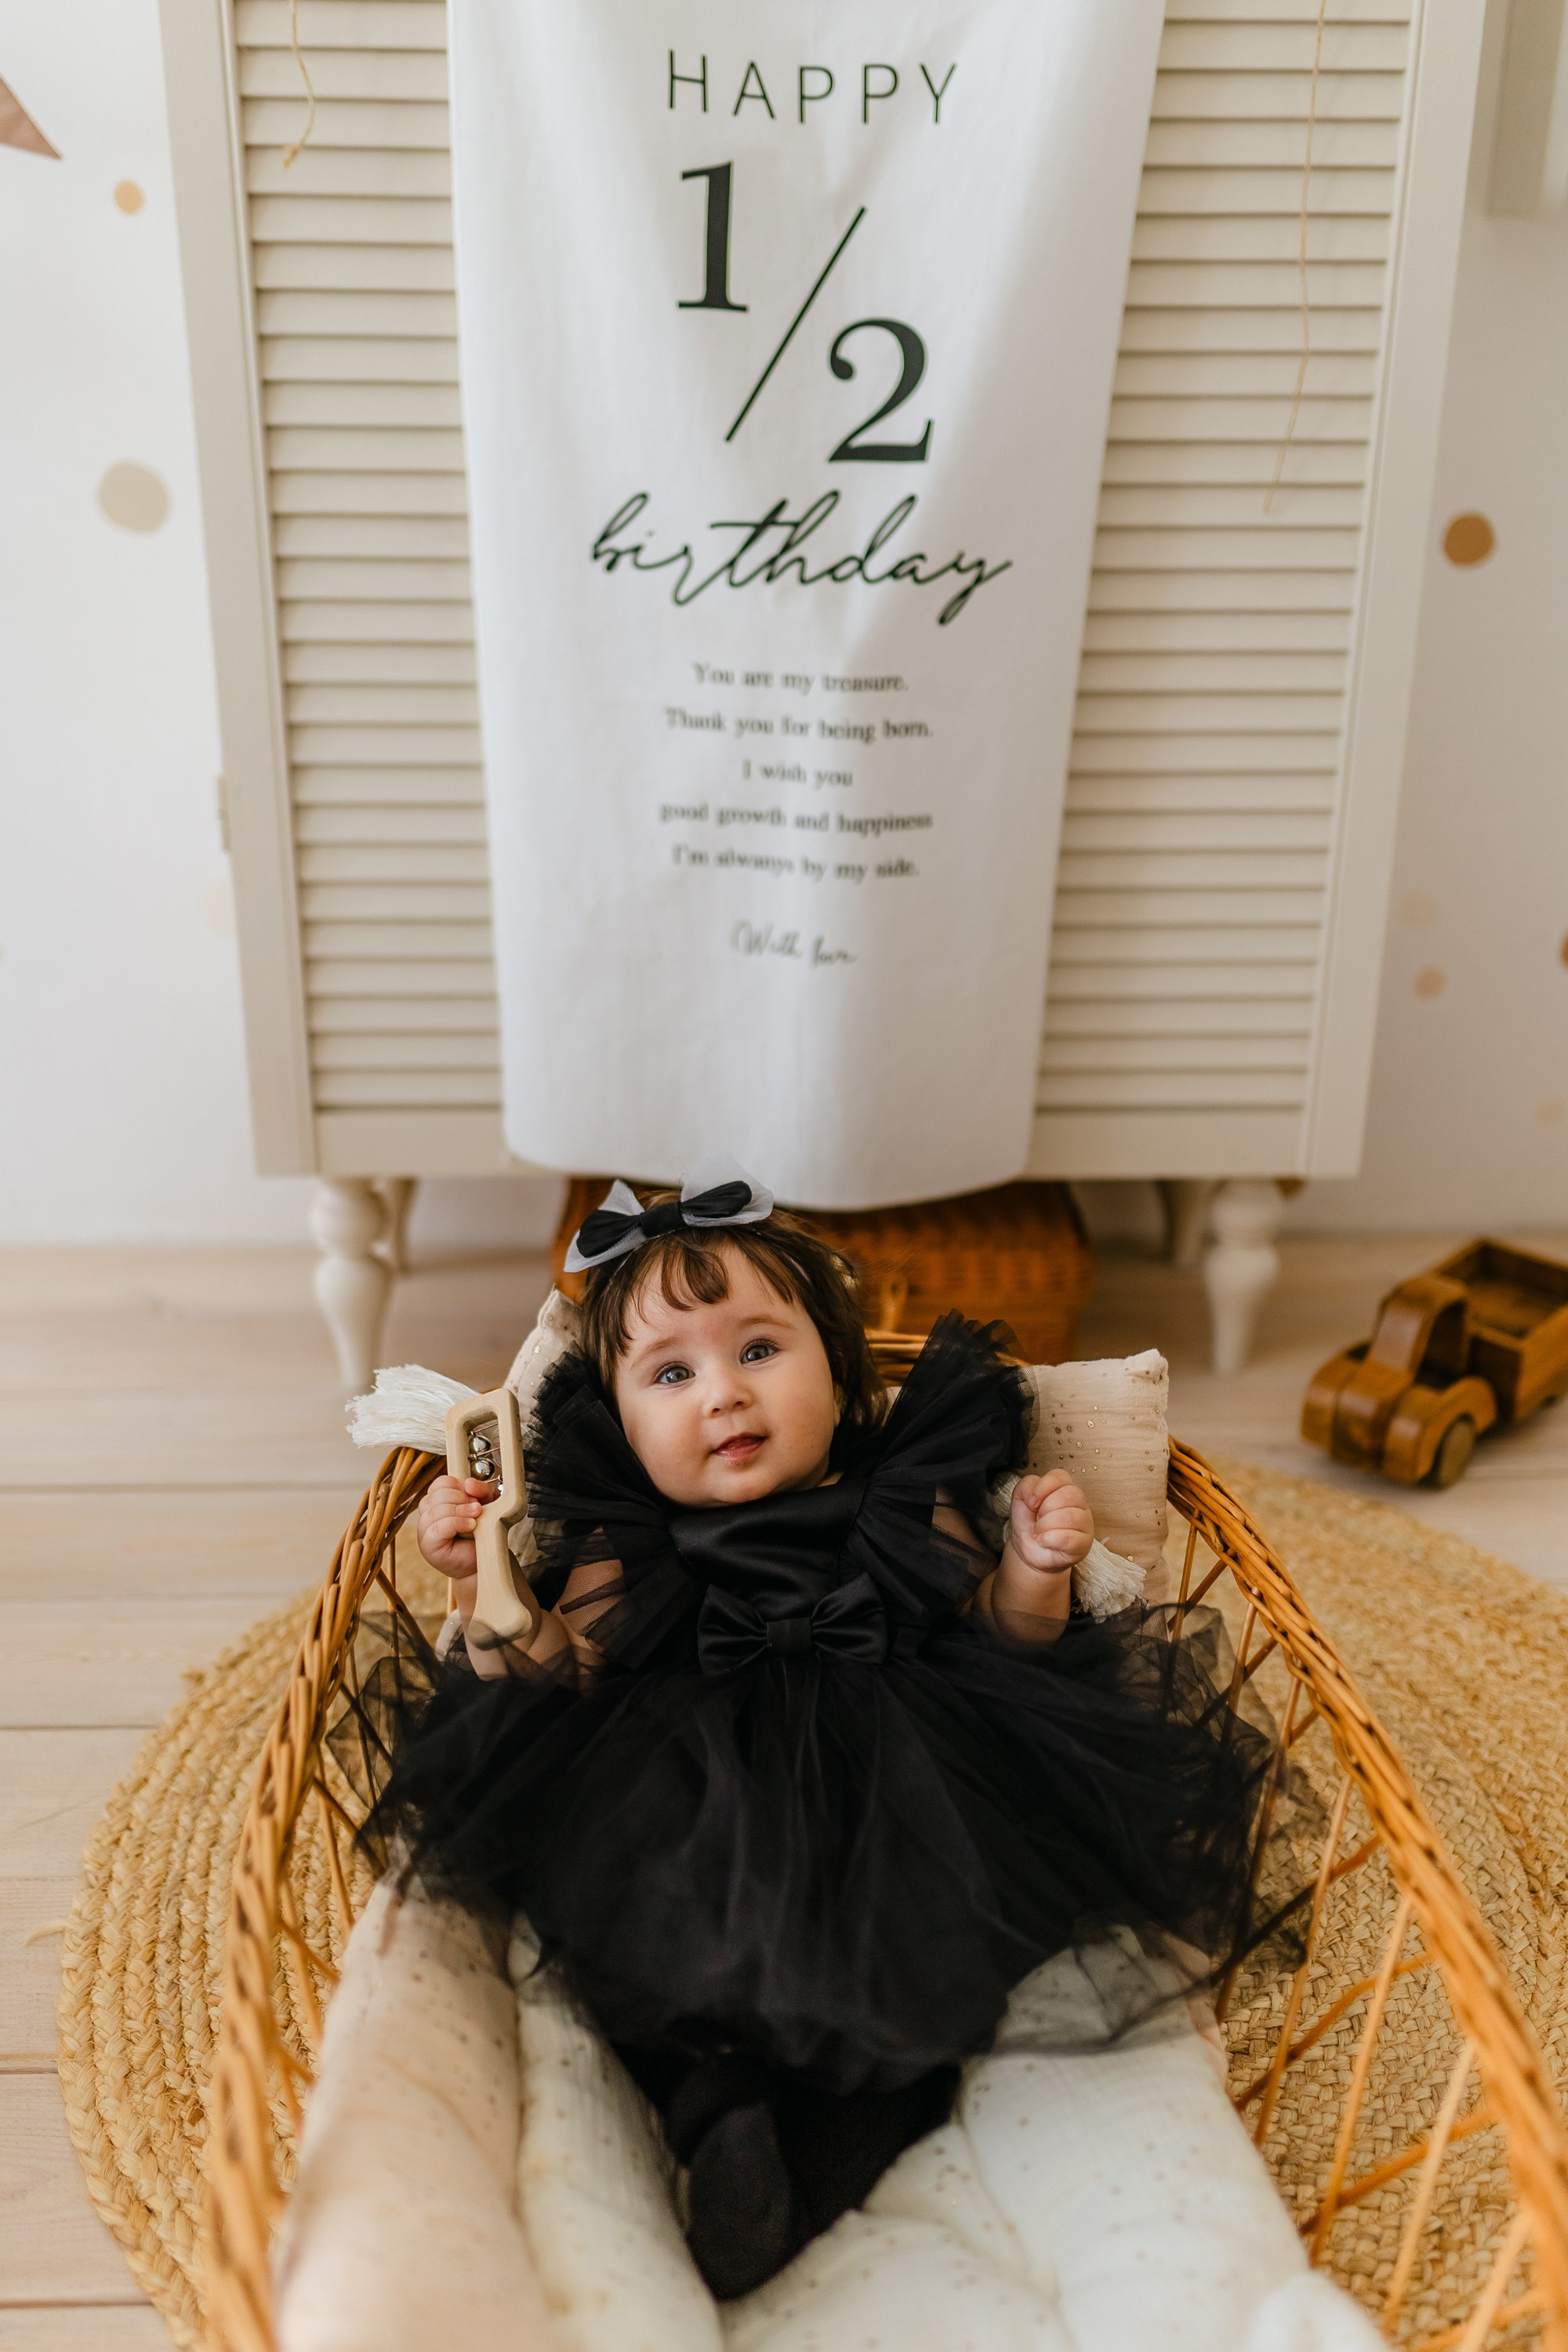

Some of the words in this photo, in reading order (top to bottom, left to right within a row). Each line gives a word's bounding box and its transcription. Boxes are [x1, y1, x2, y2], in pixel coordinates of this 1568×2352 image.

[668, 48, 958, 124] HAPPY
[591, 489, 1013, 626] birthday
[693, 662, 734, 685] You
[741, 668, 775, 687] are
[782, 673, 815, 694] my
[822, 675, 909, 692] treasure.
[666, 708, 725, 731] Thank
[734, 717, 774, 739] you
[782, 715, 810, 736] for
[818, 719, 876, 744] being
[883, 719, 935, 738] born.
[742, 760, 751, 780] I
[759, 762, 806, 783] wish
[815, 768, 854, 789] you
[659, 802, 709, 822] good
[716, 805, 785, 826] growth
[794, 812, 829, 832] and
[836, 812, 933, 837] happiness
[672, 844, 709, 865] I'm
[800, 856, 824, 881] by
[833, 863, 868, 884] my
[875, 858, 920, 879] side.
